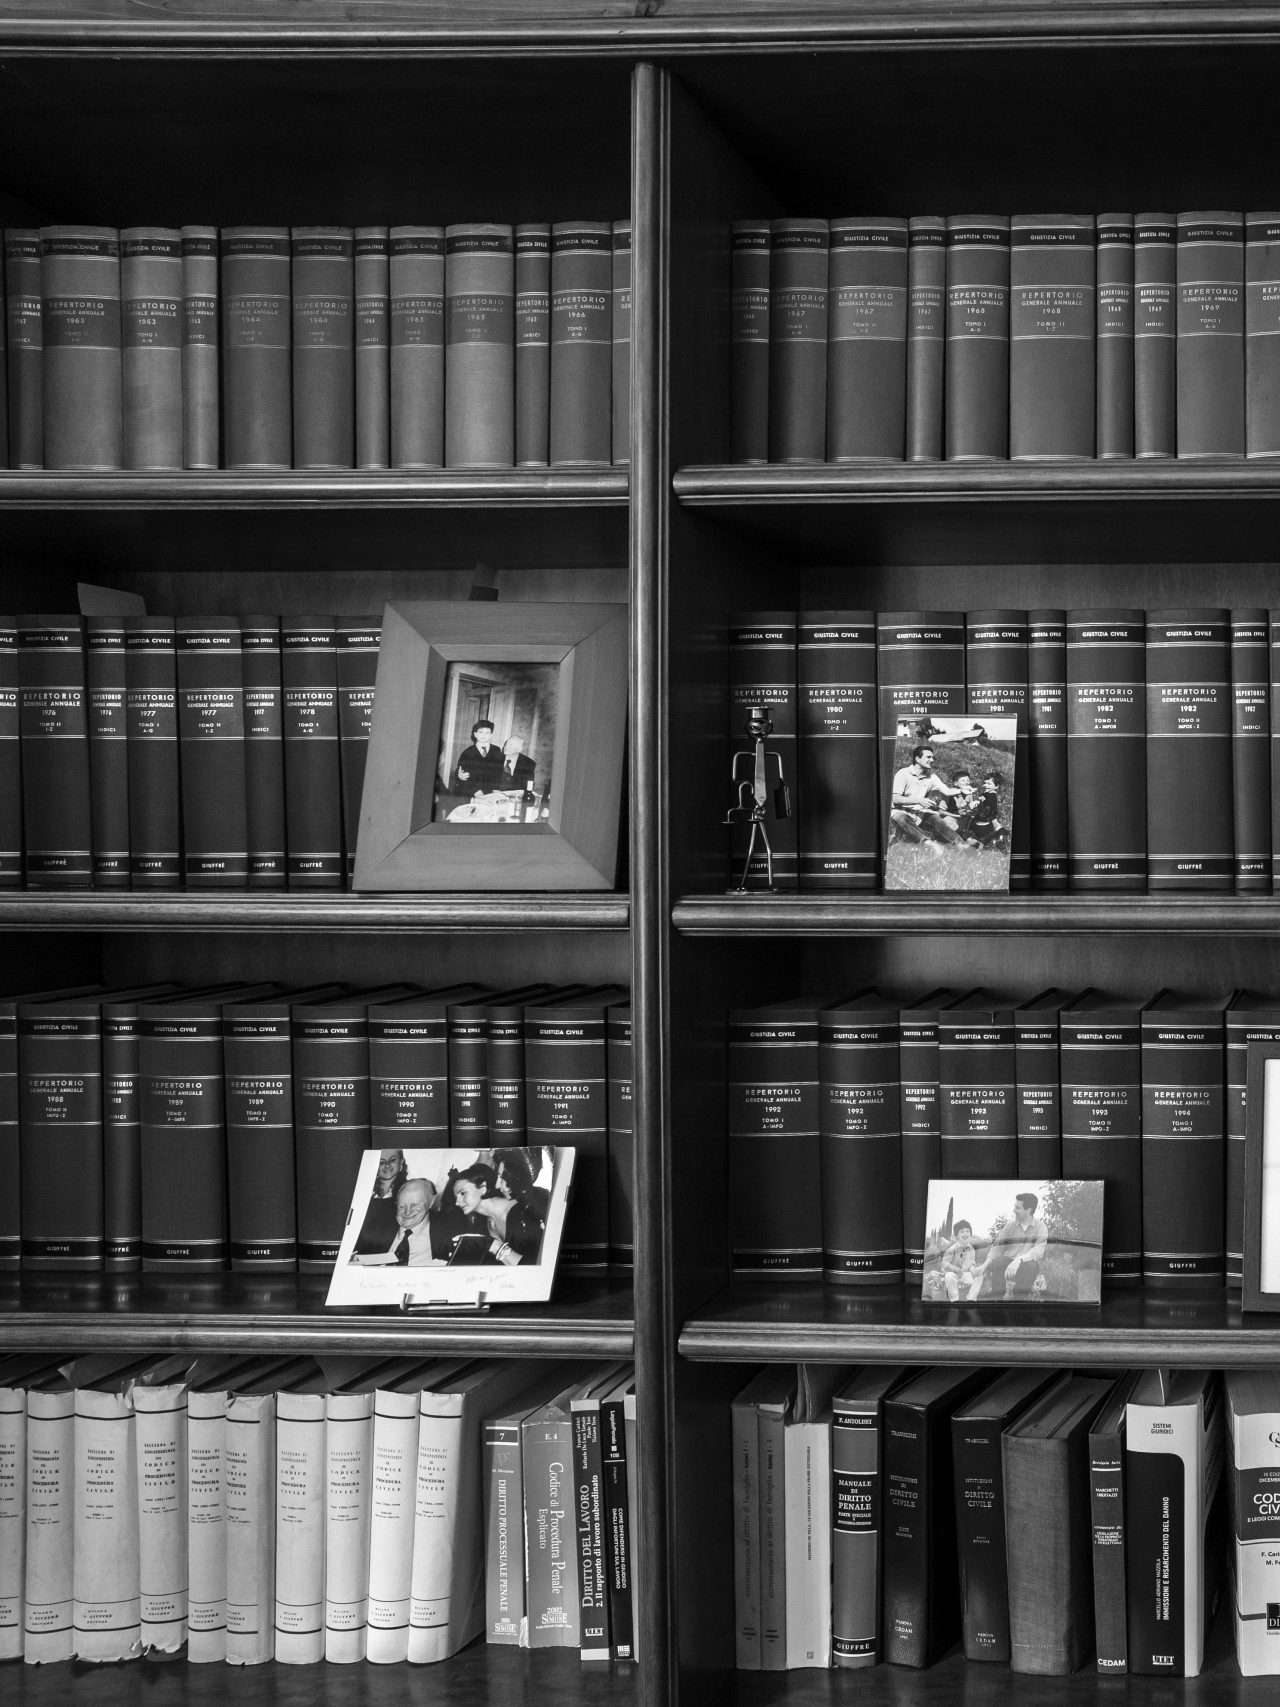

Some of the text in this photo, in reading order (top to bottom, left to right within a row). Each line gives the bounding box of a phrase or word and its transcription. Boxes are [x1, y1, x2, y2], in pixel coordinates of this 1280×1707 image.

[537, 1085, 589, 1093] REPERTORIO
[745, 1088, 800, 1096] REPERTORIO
[830, 1089, 884, 1097] REPERTORIO
[971, 1107, 987, 1115] 1993
[1092, 1109, 1108, 1117] 1993
[549, 1461, 564, 1498] Codice
[579, 1484, 591, 1532] LAVORO
[591, 1475, 600, 1520] subordinato
[838, 1493, 872, 1502] DIRITTO
[838, 1502, 872, 1511] PENALE
[892, 1498, 916, 1509] CIVILE
[968, 1500, 993, 1508] CIVILE
[1162, 1496, 1170, 1518] DANNO
[538, 1508, 549, 1549] Esplicato
[550, 1510, 565, 1558] Procedura
[592, 1523, 601, 1547] lavoro
[1162, 1519, 1170, 1532] DEL
[498, 1479, 508, 1612] DIRITTO PROCESSUALE PENALE
[583, 1535, 592, 1556] DEL
[593, 1548, 601, 1556] di
[1162, 1534, 1170, 1579] RISARCIMENTO
[552, 1561, 567, 1594] Penale
[580, 1559, 594, 1607] DIRITTO
[594, 1558, 605, 1592] rapporto
[1162, 1586, 1170, 1620] IMMISSIONI
[1098, 1658, 1126, 1667] CEDAM
